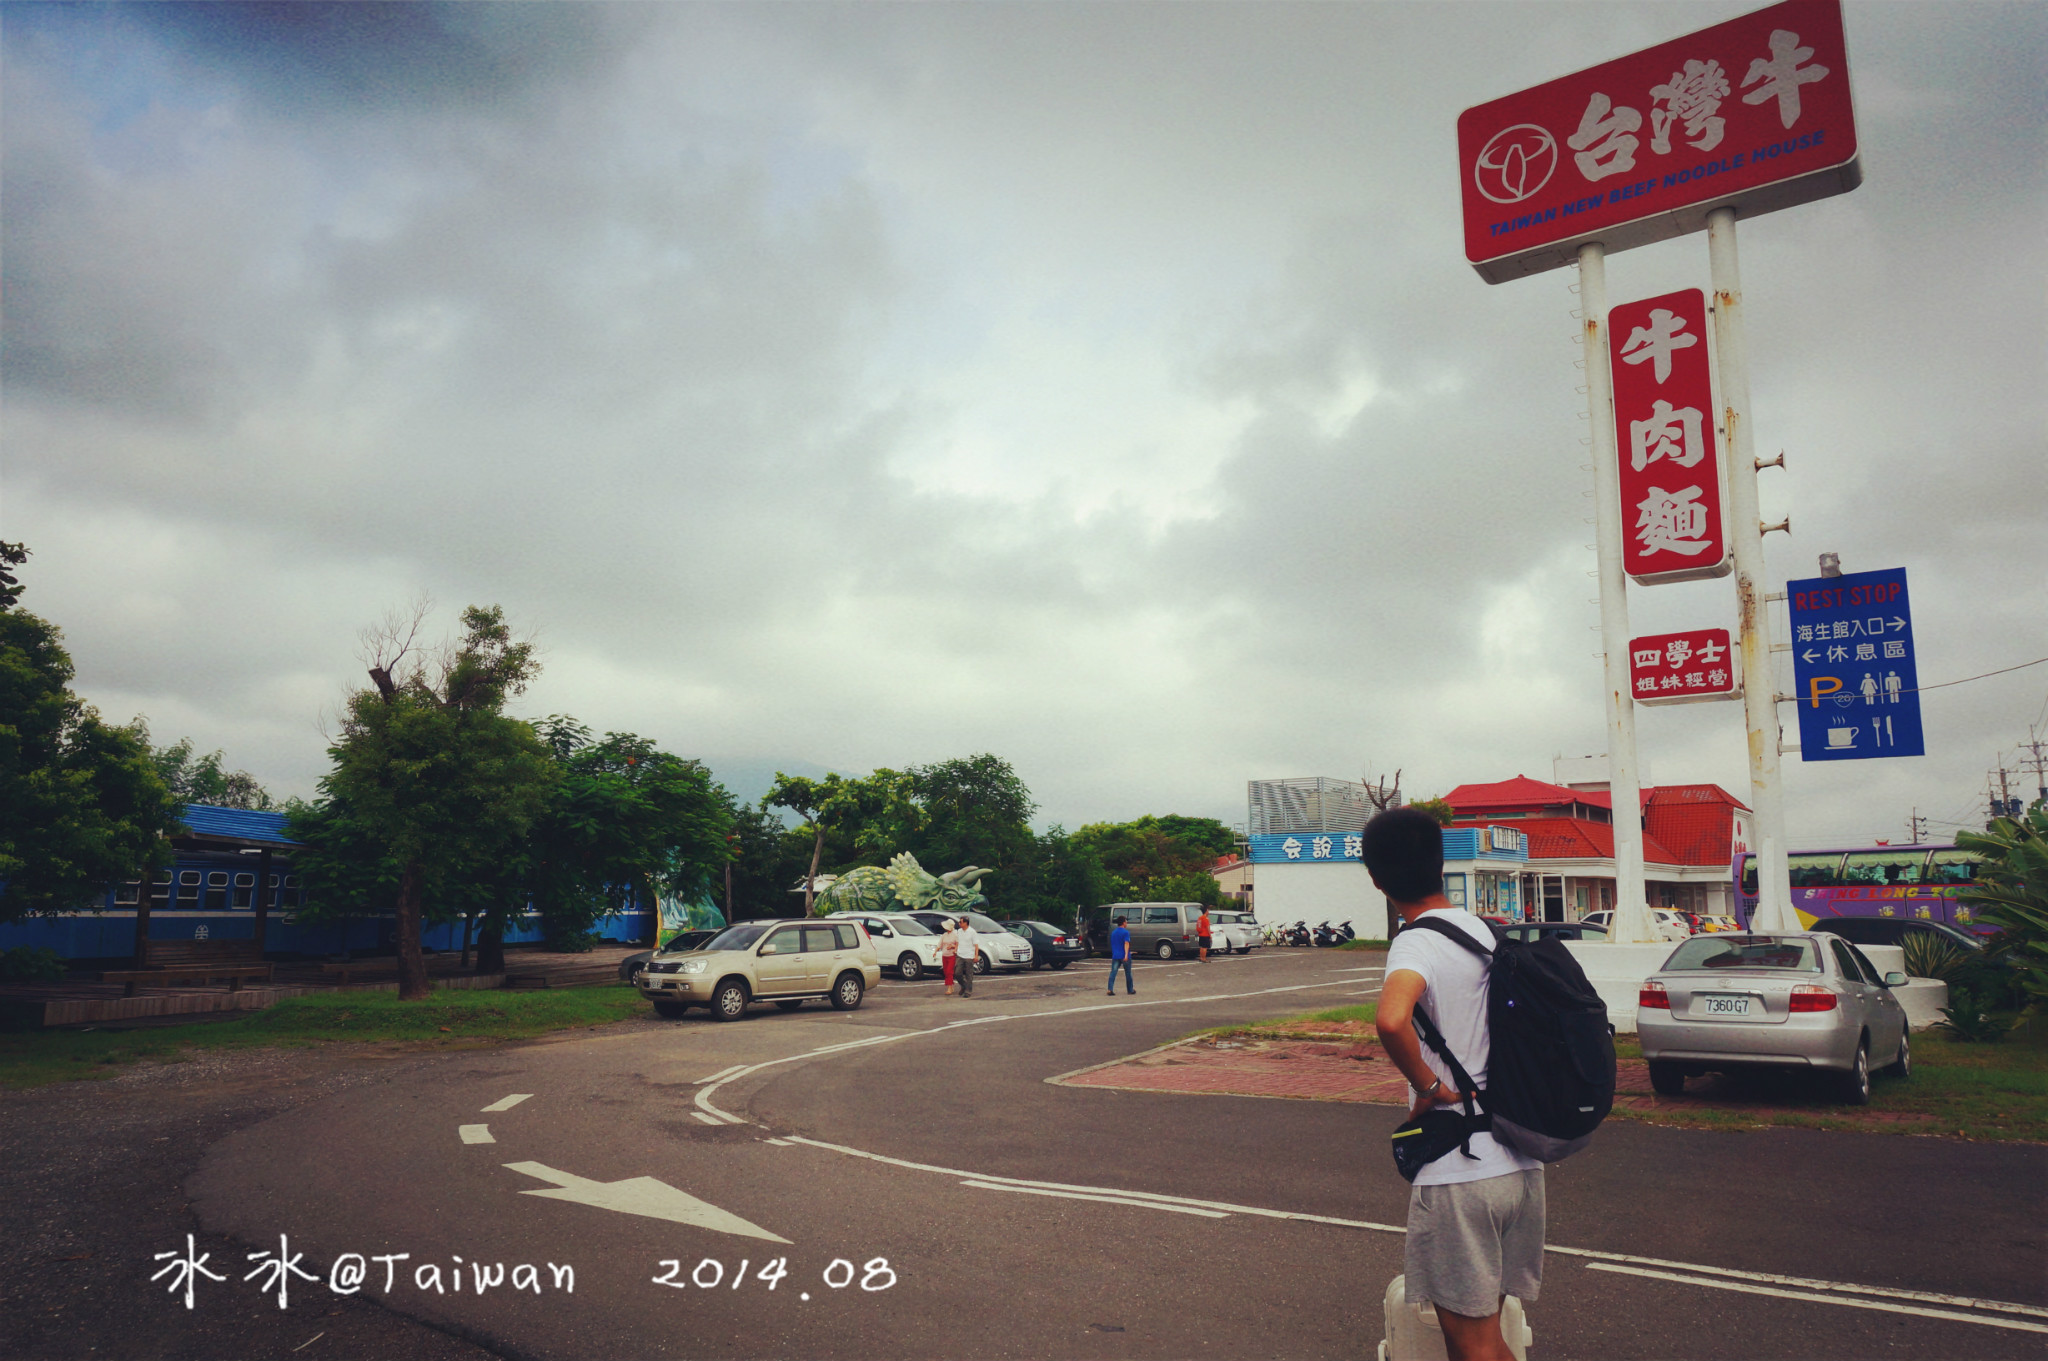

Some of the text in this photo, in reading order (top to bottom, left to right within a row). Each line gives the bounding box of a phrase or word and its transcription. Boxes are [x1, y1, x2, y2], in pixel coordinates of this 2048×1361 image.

[1567, 29, 1830, 182] 台灣牛
[1489, 130, 1825, 238] TAIWAN NEW BEEF NOODLE HOUSE
[1619, 308, 1713, 557] 牛肉麵
[1795, 582, 1901, 612] REST STOP
[1797, 617, 1885, 643] 海生館入口
[1633, 639, 1726, 669] 四學士
[1826, 640, 1906, 663] 休息區
[1636, 668, 1727, 691] 姐妹經營
[1810, 676, 1843, 708] P
[1804, 888, 1861, 900] SHING
[1867, 887, 1919, 898] LONG
